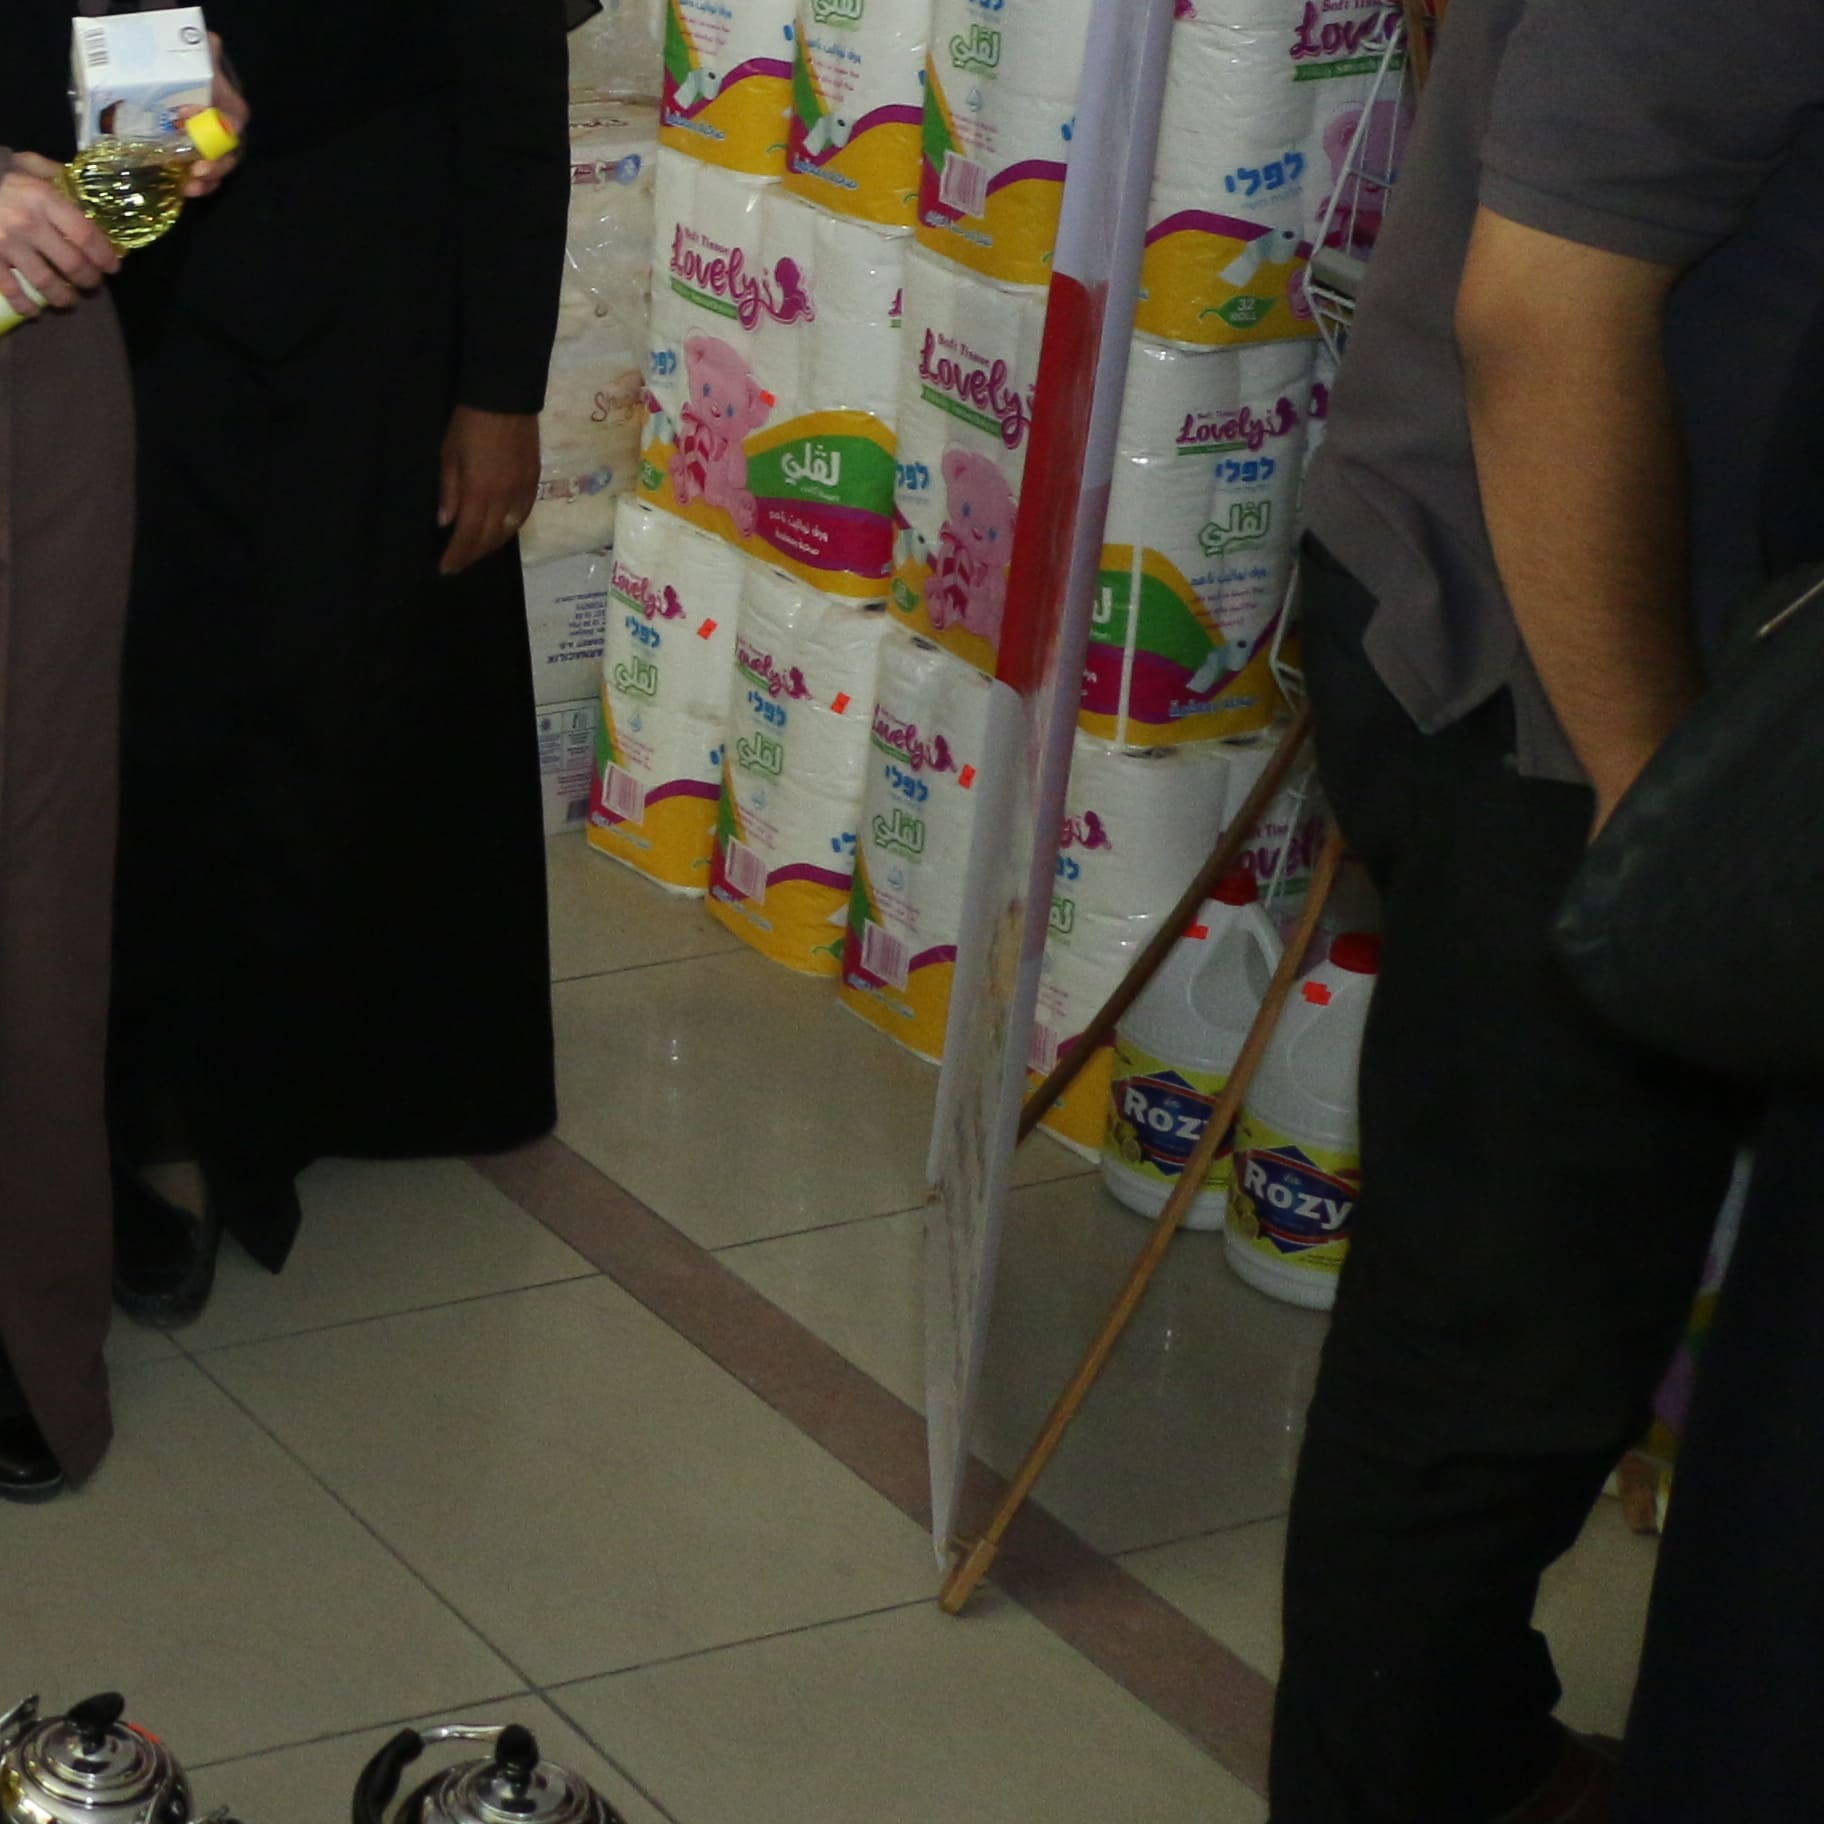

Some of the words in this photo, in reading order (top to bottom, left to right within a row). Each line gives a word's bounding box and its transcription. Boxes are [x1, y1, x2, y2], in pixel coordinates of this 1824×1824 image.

[670, 222, 764, 332] Lovely
[919, 327, 1029, 450] Lovely
[1242, 1158, 1352, 1232] Rozy
